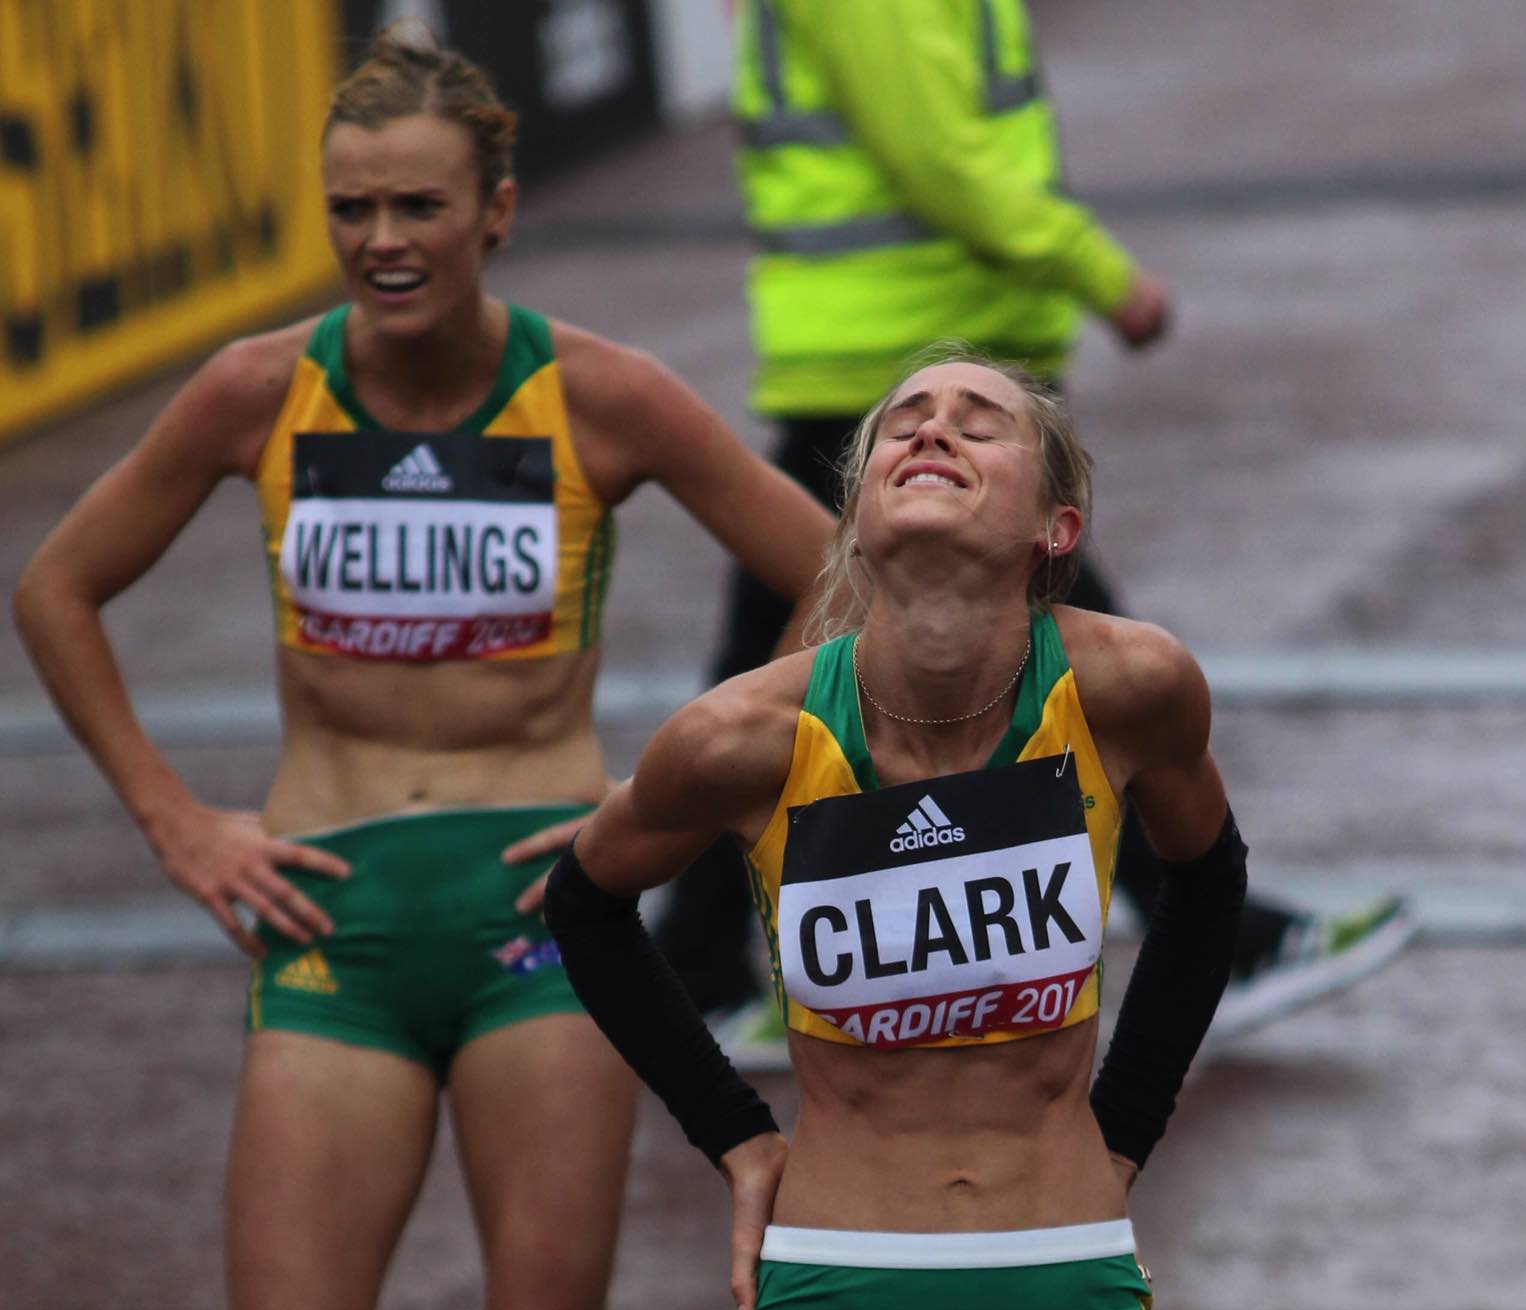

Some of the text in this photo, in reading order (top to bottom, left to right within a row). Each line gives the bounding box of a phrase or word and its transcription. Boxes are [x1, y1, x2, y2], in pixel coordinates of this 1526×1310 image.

[297, 523, 542, 594] WELLINGS
[889, 826, 966, 853] adidas
[799, 861, 1087, 987] CLARK
